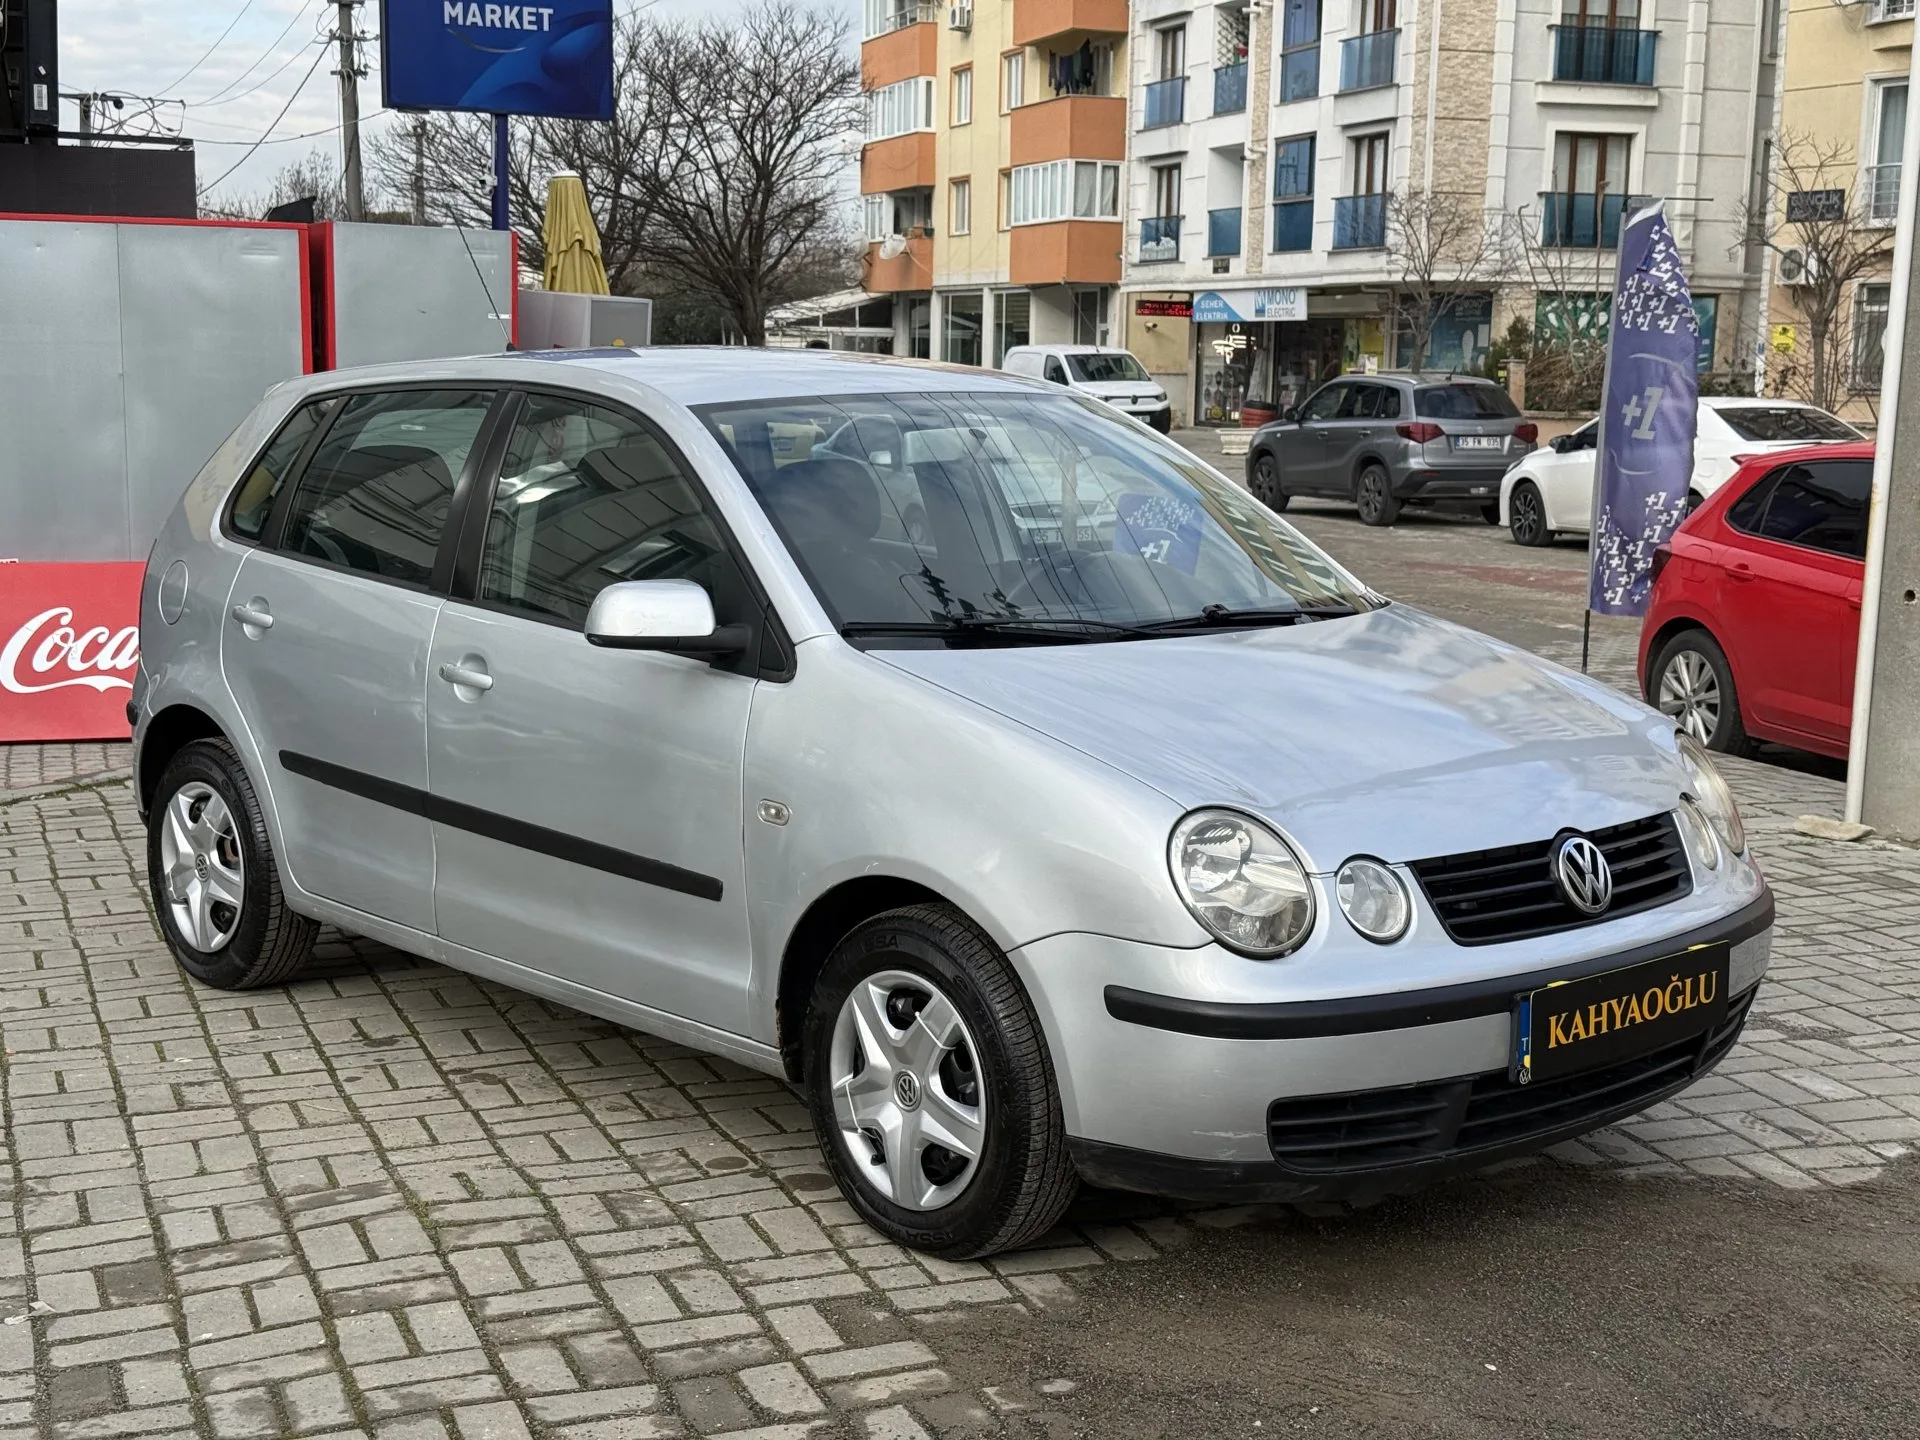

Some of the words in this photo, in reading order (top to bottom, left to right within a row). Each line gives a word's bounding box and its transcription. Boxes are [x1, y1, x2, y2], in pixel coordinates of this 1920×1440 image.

[444, 1, 554, 31] MARKET
[1267, 288, 1296, 305] MONO
[1267, 307, 1296, 318] ELECTRIC
[1657, 315, 1680, 334] +1
[1621, 386, 1664, 440] +1
[1140, 539, 1171, 565] +1
[0, 606, 139, 693] Coca
[1547, 970, 1719, 1050] KAHYAOĞLU
